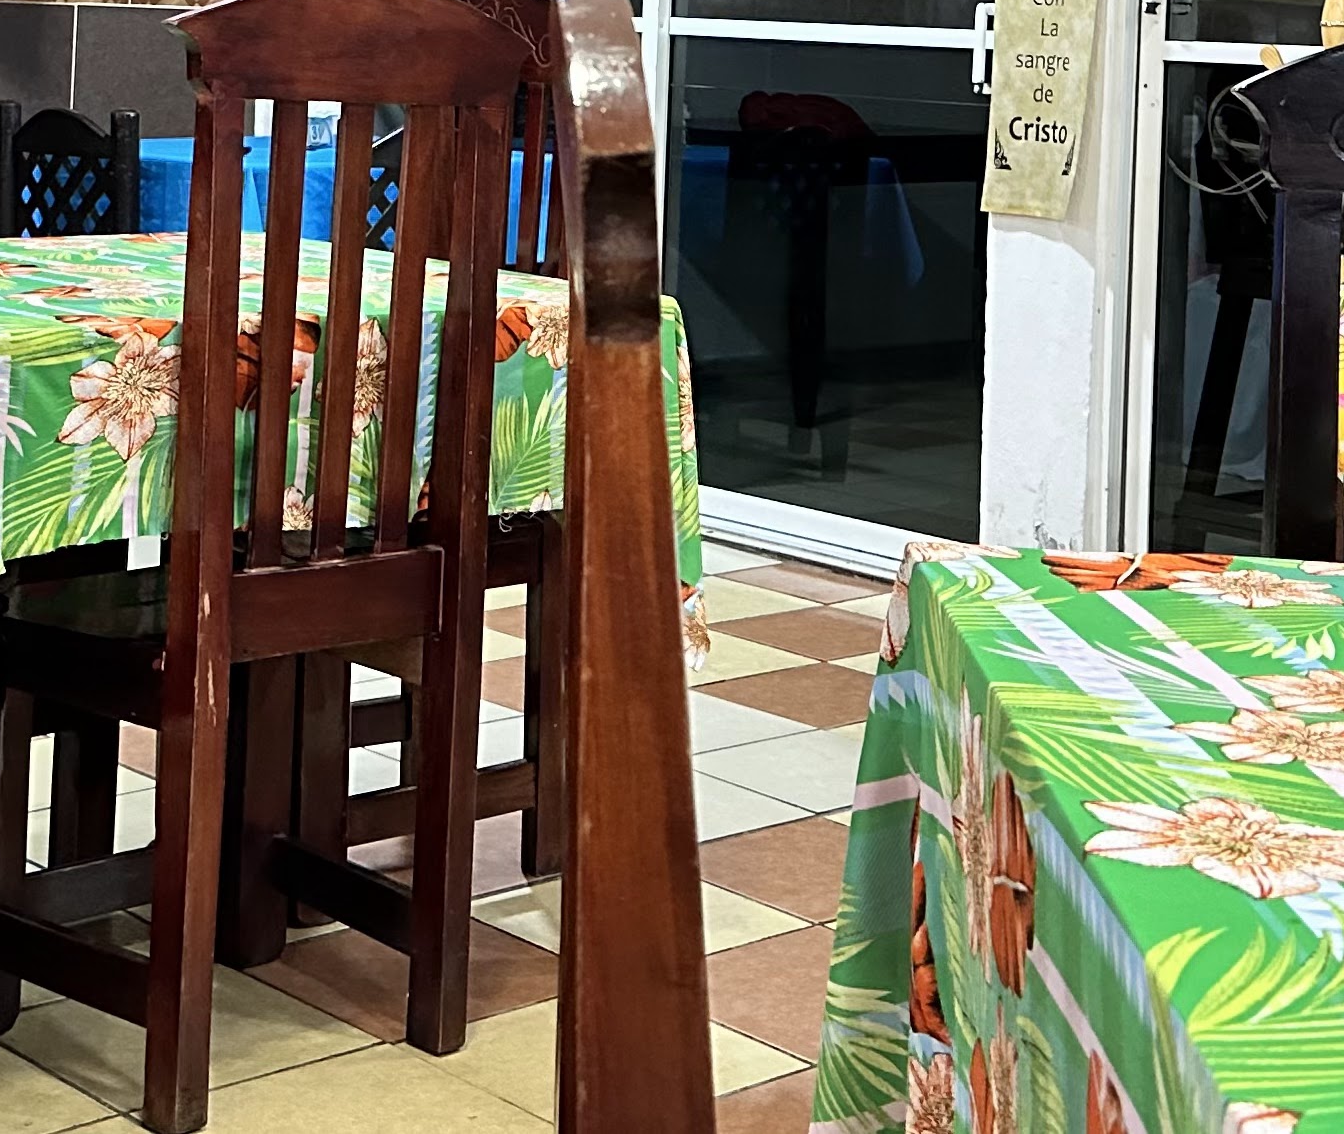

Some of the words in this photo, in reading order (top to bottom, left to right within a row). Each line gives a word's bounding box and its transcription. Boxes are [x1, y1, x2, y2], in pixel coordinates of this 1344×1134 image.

[1040, 17, 1059, 37] La
[1015, 53, 1070, 77] sangre
[1032, 83, 1054, 104] de
[1008, 115, 1068, 145] Cristo
